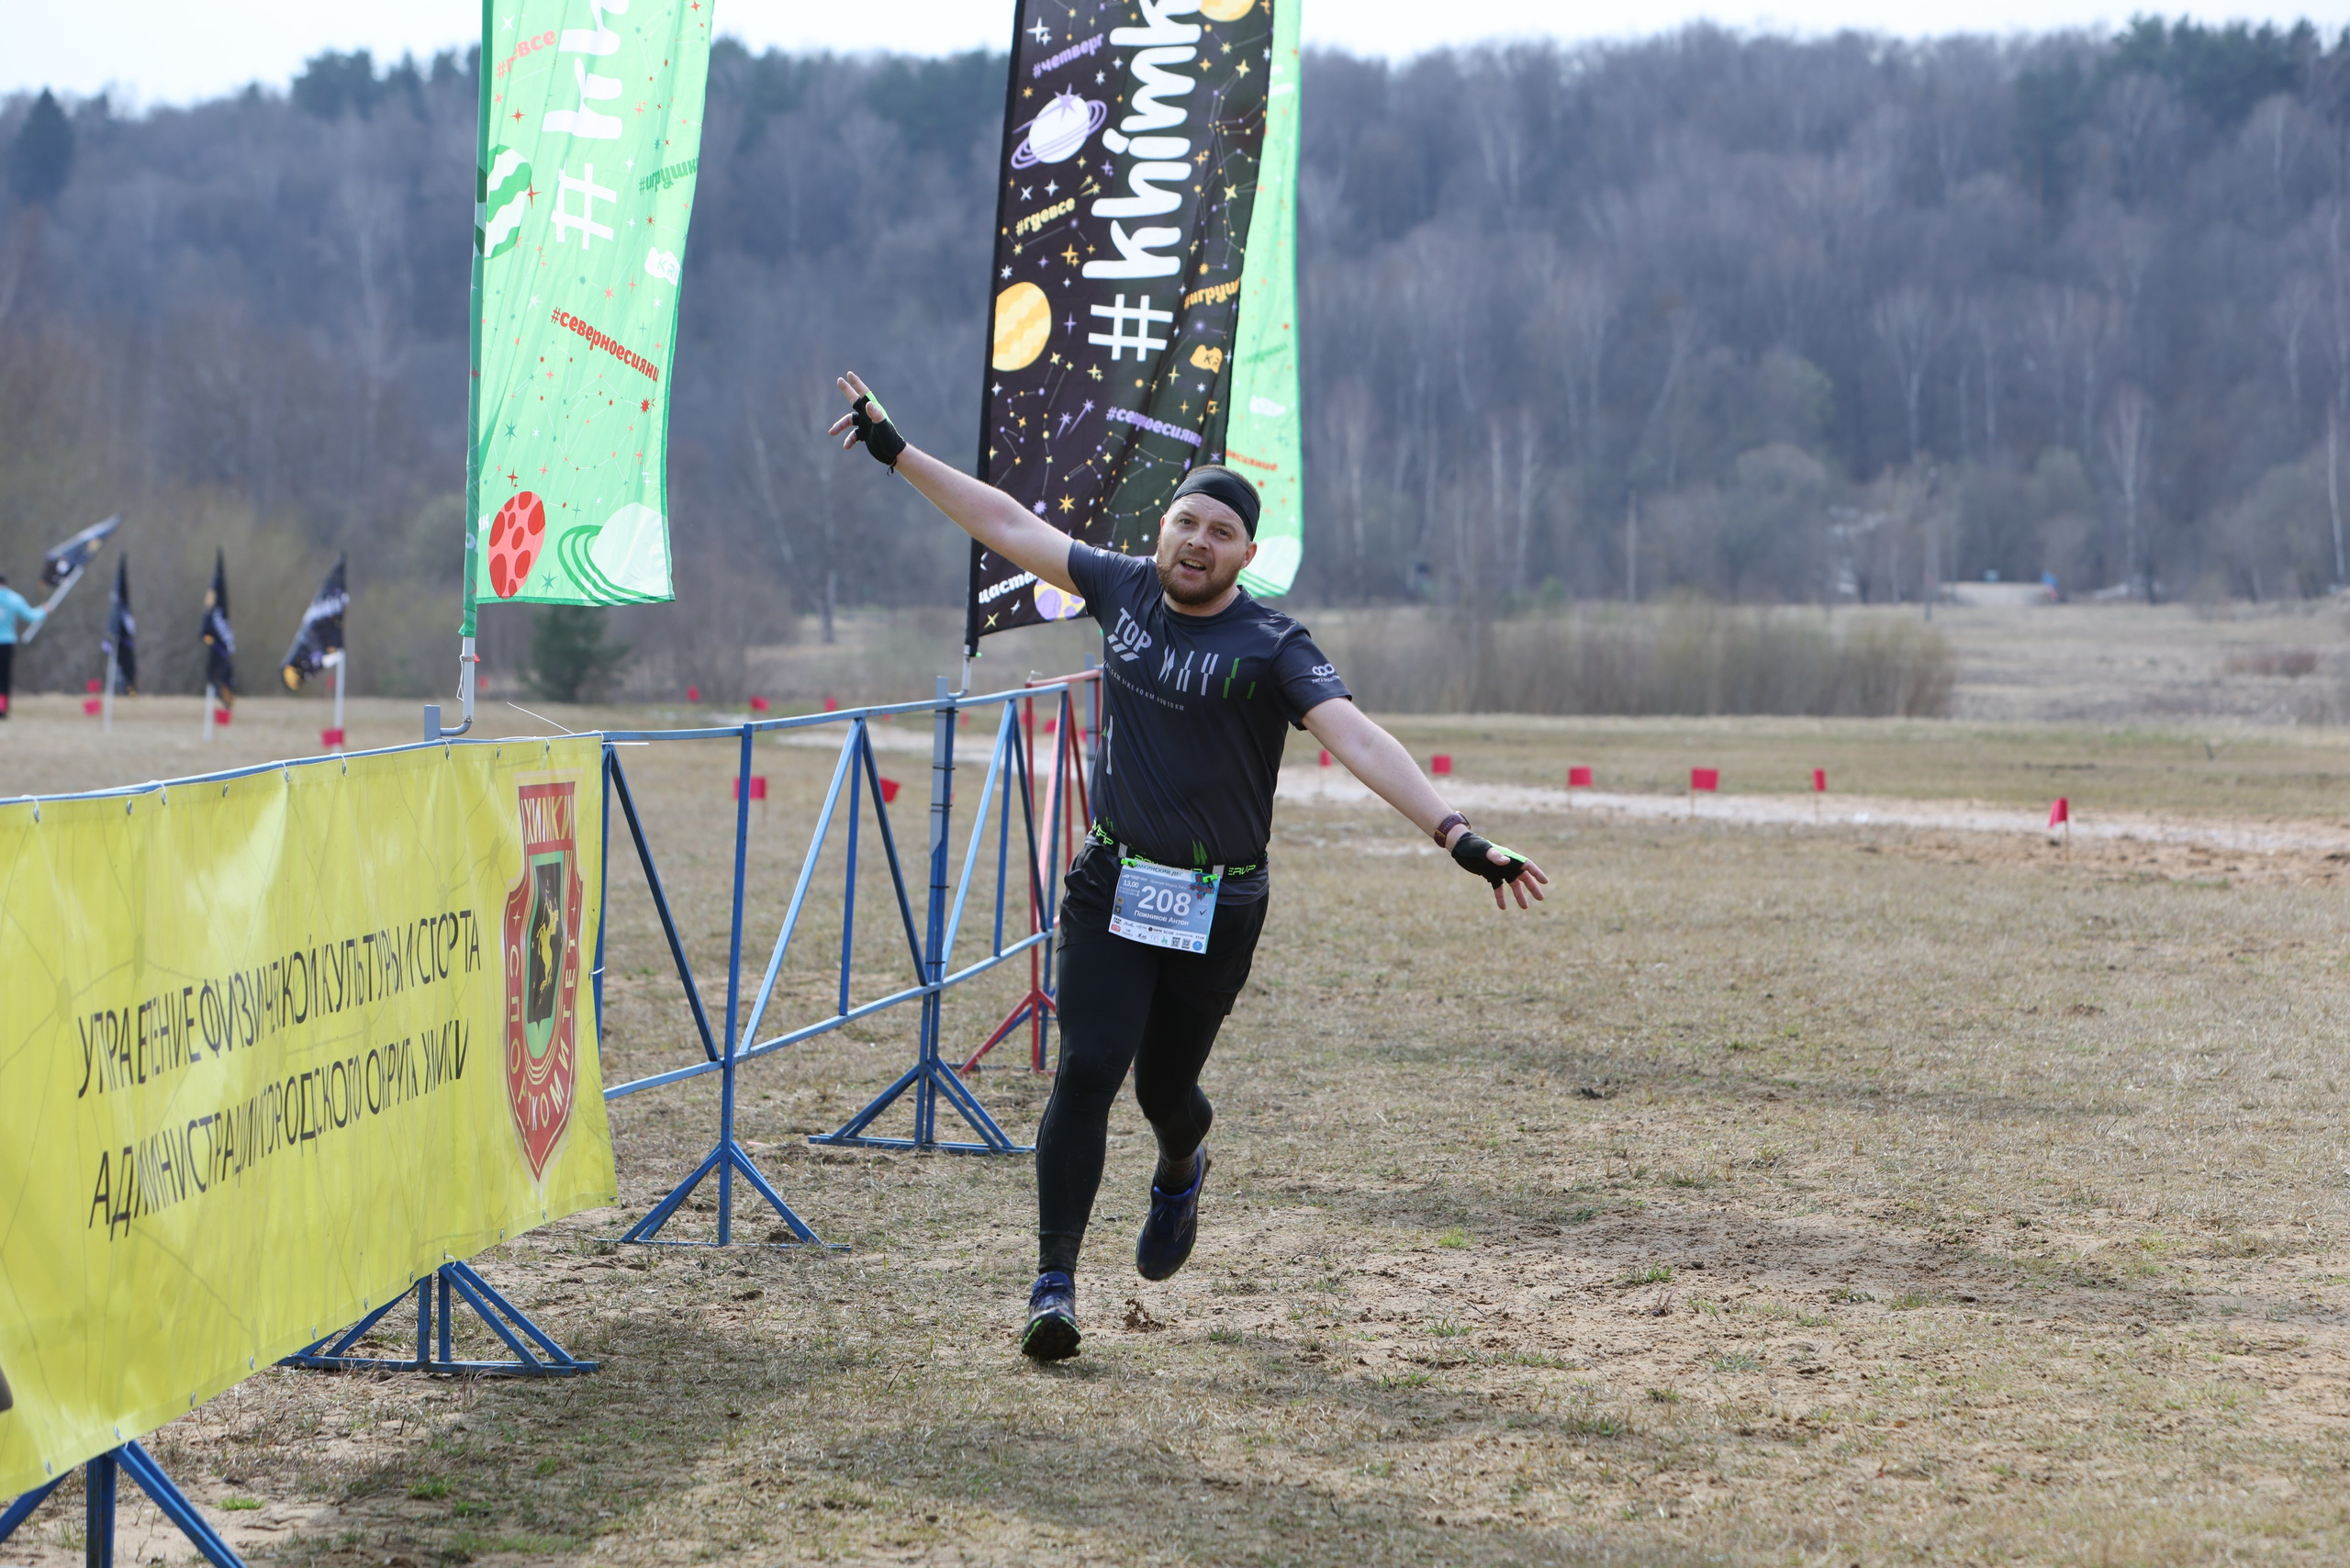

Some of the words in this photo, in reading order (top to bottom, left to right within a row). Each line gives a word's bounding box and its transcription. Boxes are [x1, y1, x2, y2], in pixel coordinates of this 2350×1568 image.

[1033, 33, 1104, 79] #четверг
[1015, 197, 1076, 236] #гдевсе
[1114, 607, 1152, 653] TOP
[523, 795, 574, 845] ХИМКИ
[1138, 885, 1192, 916] 208
[1168, 917, 1190, 926] Антон
